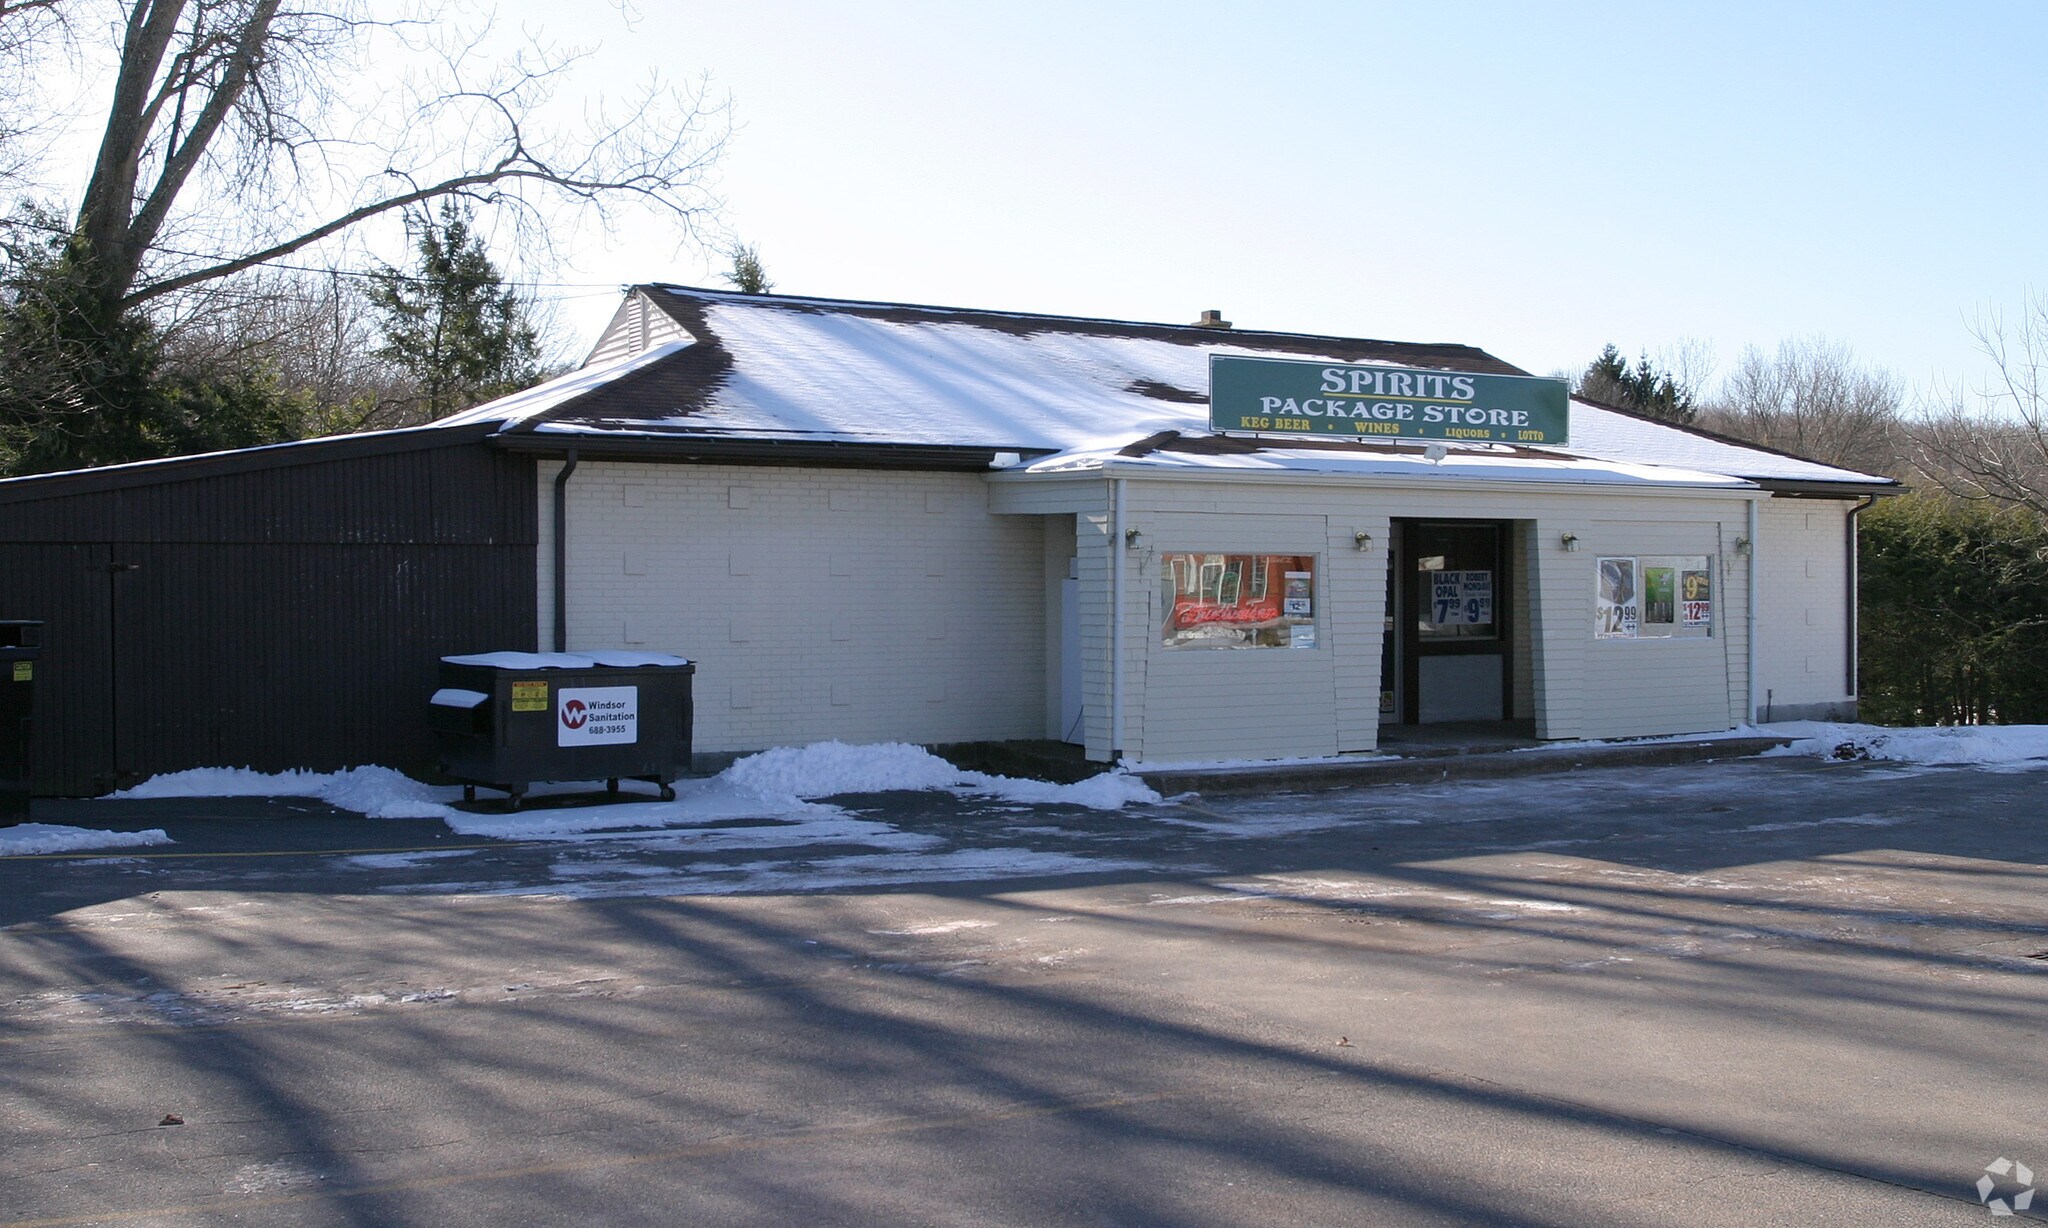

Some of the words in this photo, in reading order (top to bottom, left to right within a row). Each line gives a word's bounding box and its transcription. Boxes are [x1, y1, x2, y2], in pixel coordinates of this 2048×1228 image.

[1320, 368, 1475, 401] SPIRITS
[1260, 396, 1414, 421] PACKAGE
[1423, 405, 1529, 427] STORE
[1241, 416, 1269, 429] KEG
[1275, 418, 1310, 431] BEER
[1355, 421, 1399, 435] WINES
[1445, 428, 1490, 439] LIQUORS
[1518, 430, 1544, 441] LOTTO
[1433, 573, 1460, 585] BLACK
[1466, 573, 1488, 581] ROBERT
[1435, 586, 1458, 598] OPAL
[588, 701, 626, 710] Windsor
[588, 712, 635, 722] Sanitation
[588, 725, 626, 734] 688-3955
